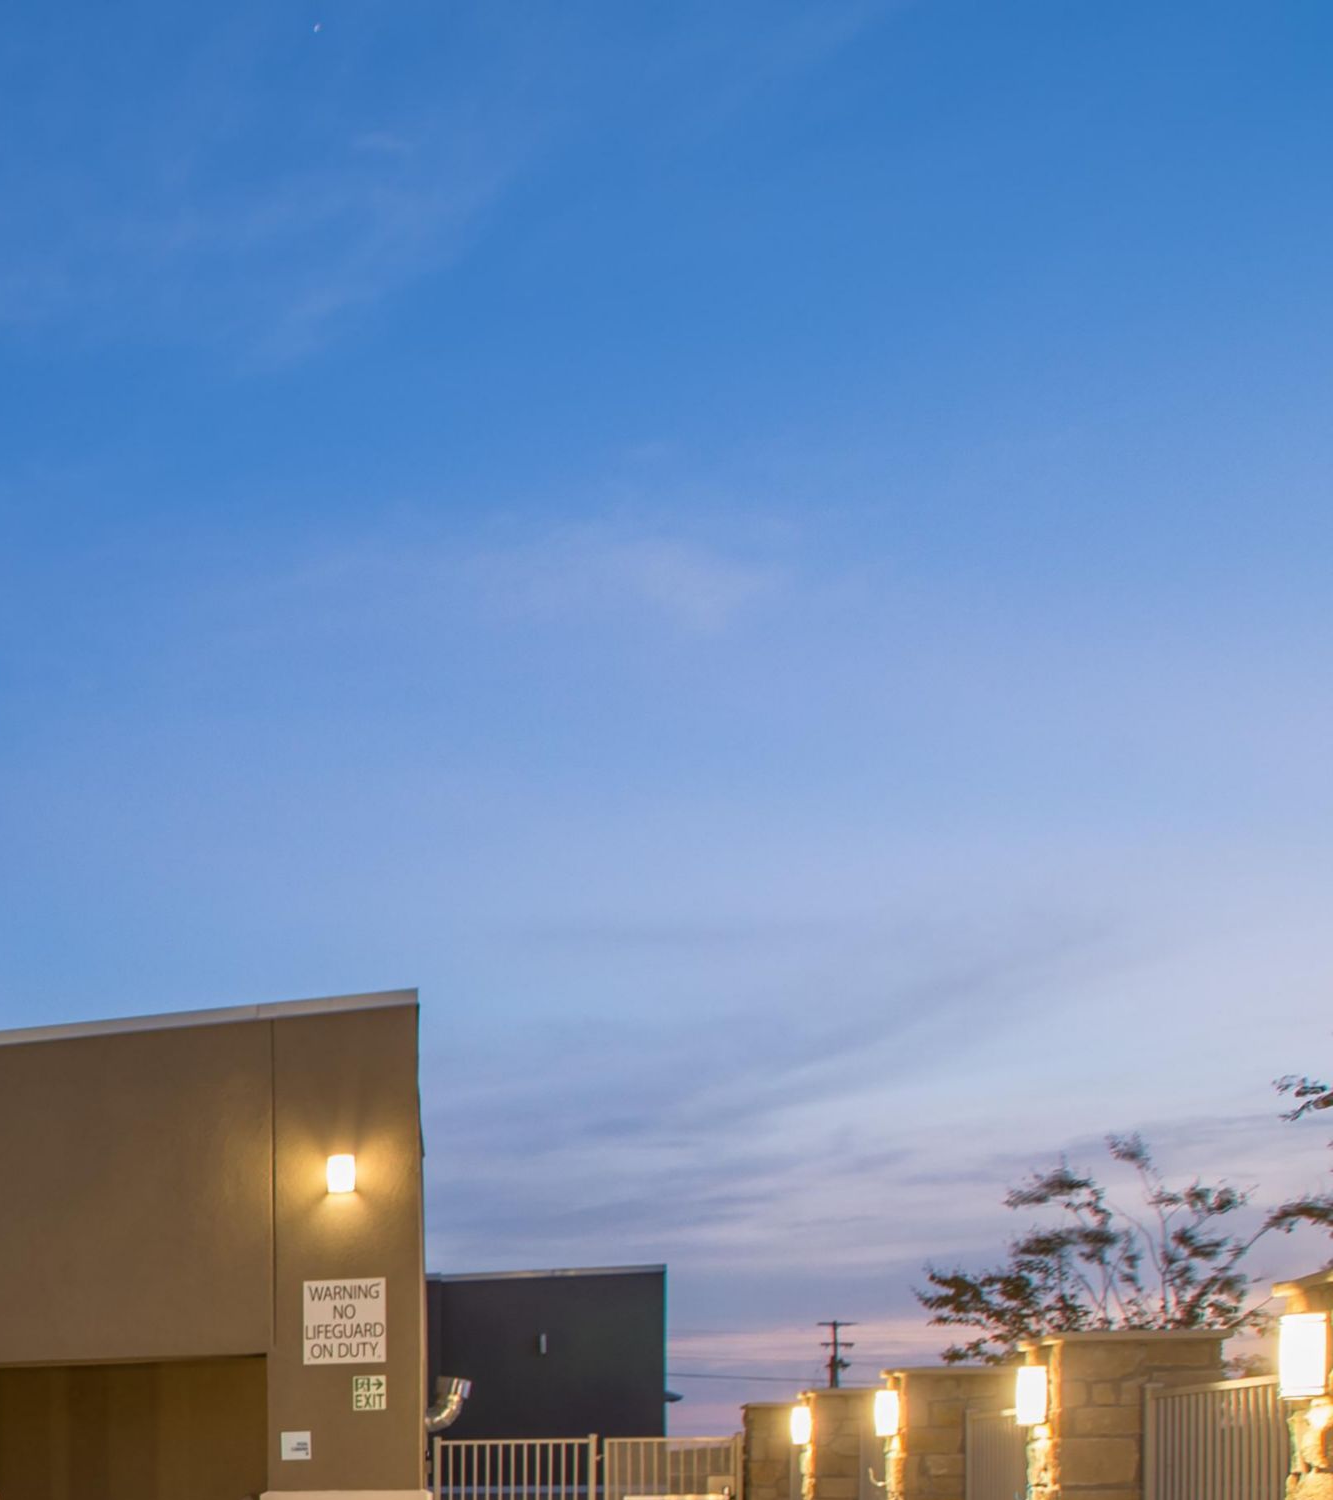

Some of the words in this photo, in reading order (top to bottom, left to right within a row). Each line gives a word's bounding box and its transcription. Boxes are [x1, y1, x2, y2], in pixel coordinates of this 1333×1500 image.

[309, 1284, 381, 1301] WARNING
[333, 1304, 356, 1319] NO
[305, 1322, 385, 1340] LIFEGUARD
[310, 1343, 334, 1359] ON
[338, 1342, 378, 1358] DUTY
[355, 1393, 385, 1409] EXIT
